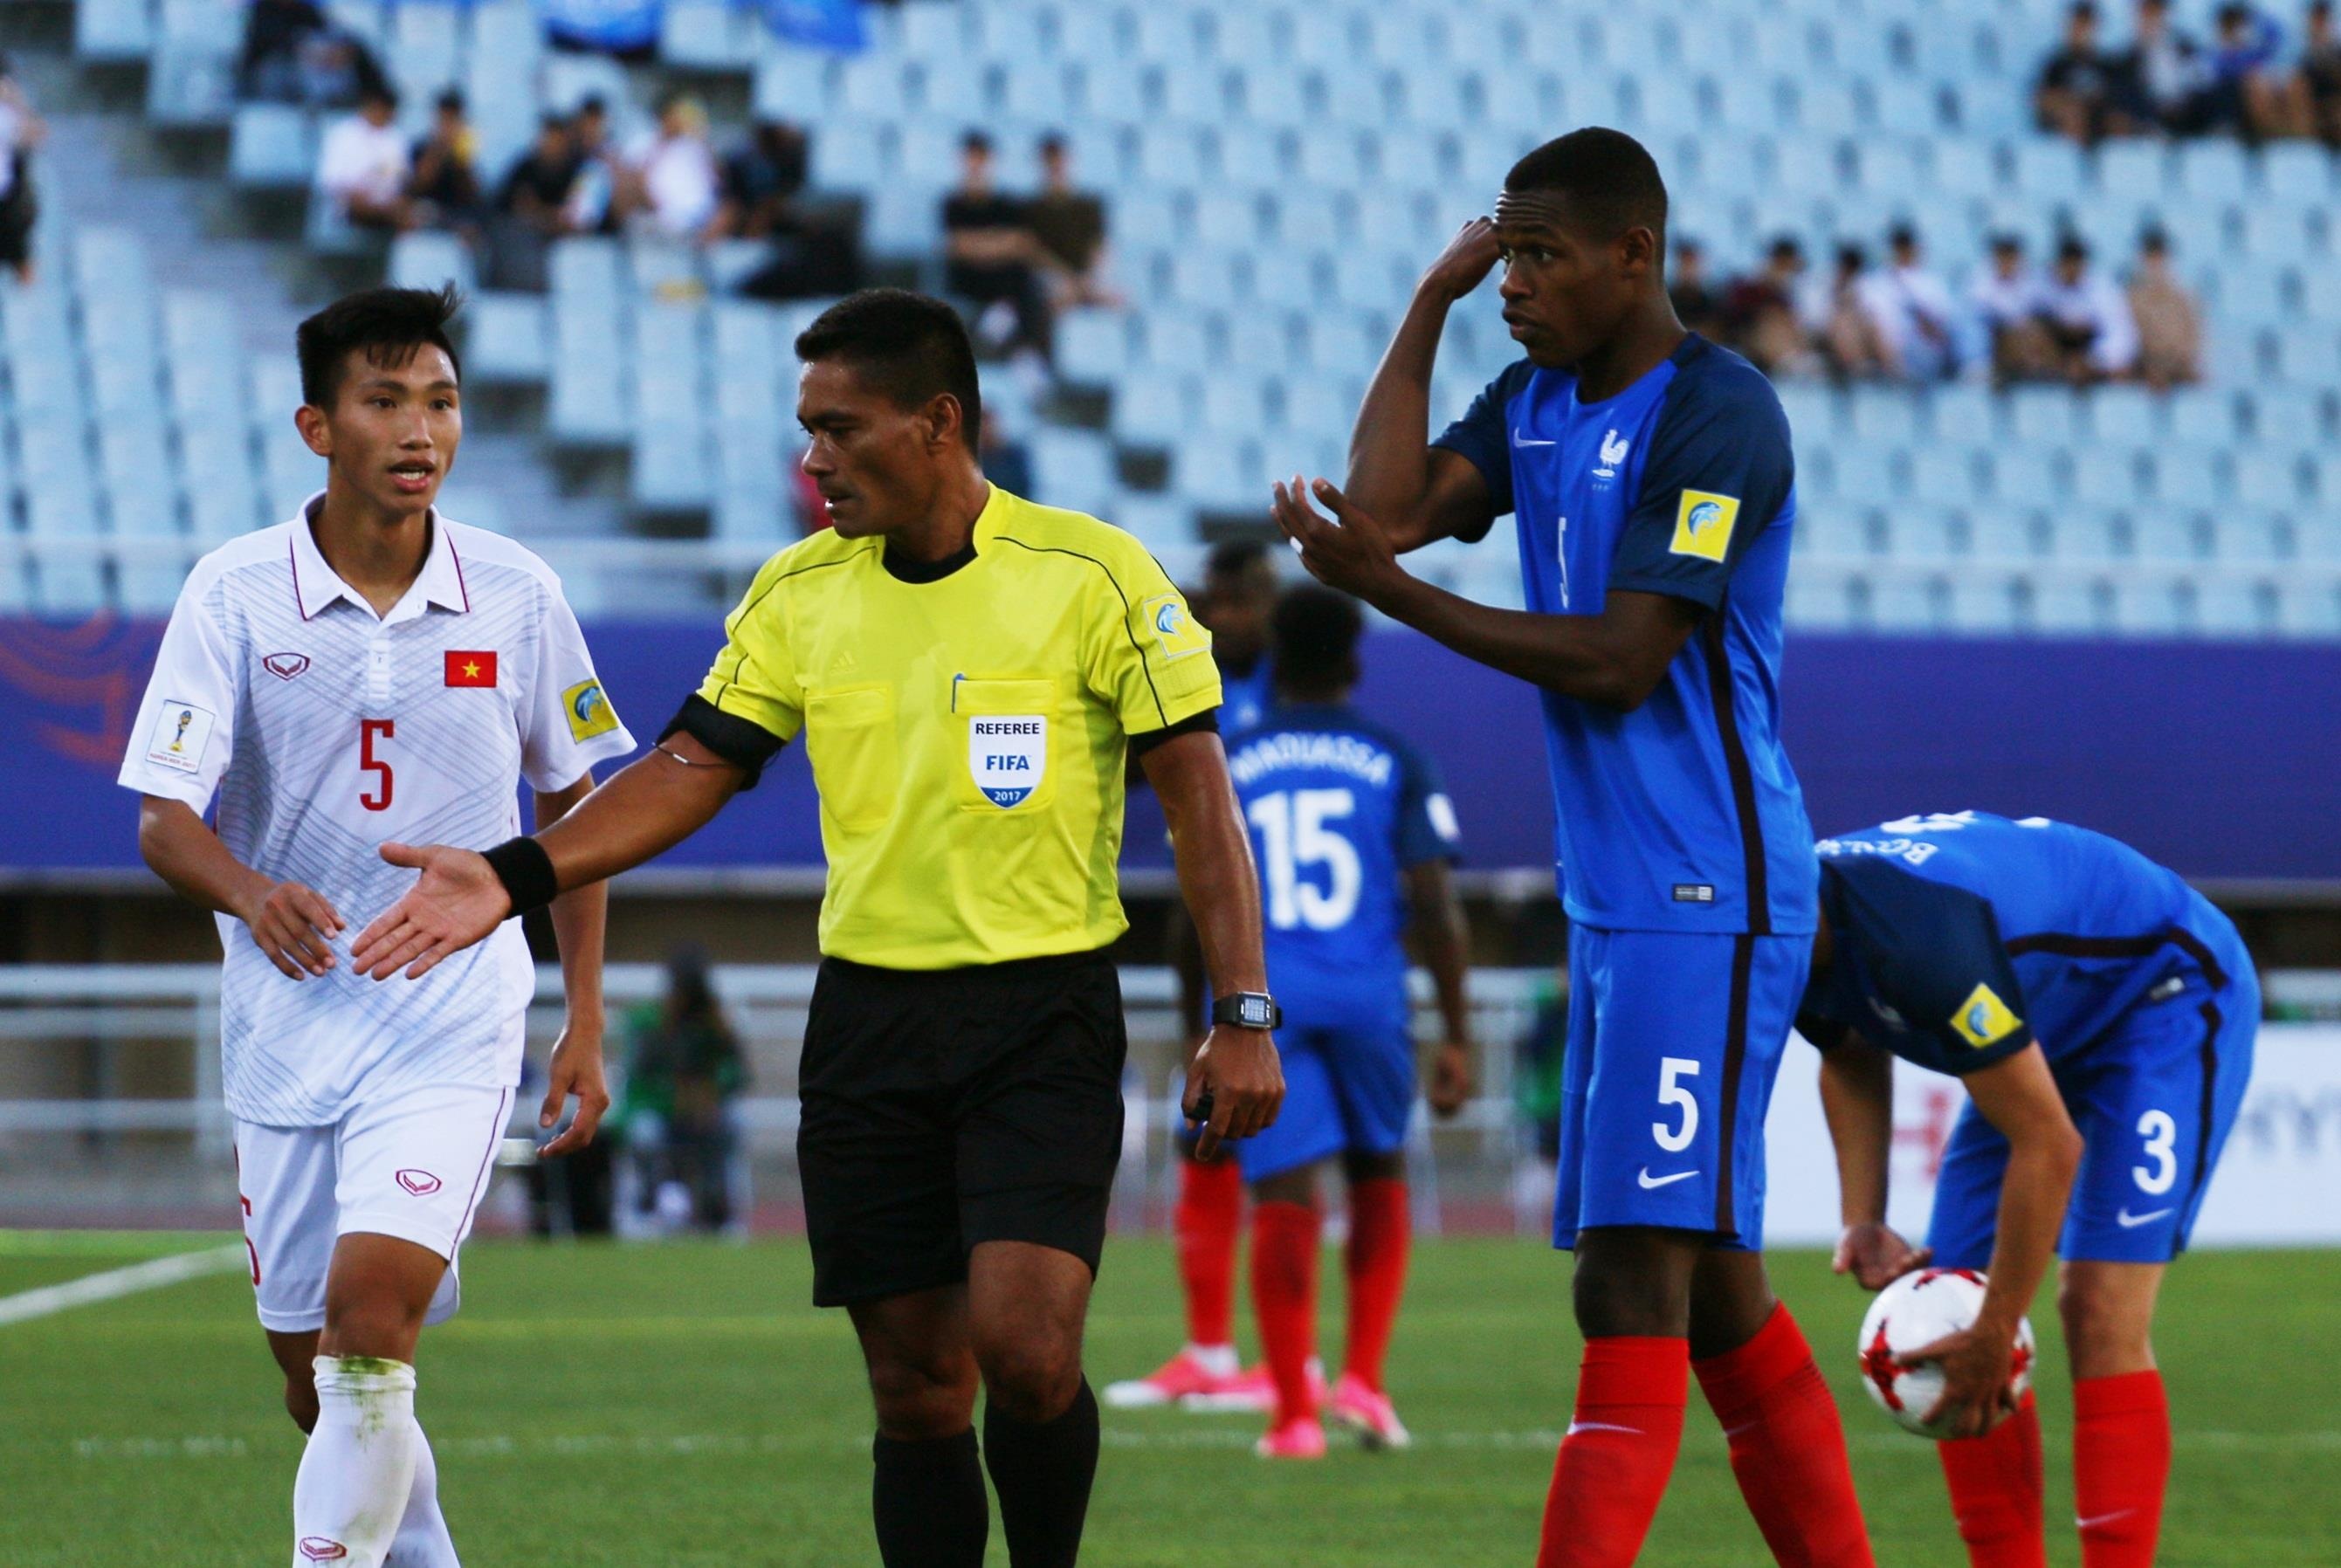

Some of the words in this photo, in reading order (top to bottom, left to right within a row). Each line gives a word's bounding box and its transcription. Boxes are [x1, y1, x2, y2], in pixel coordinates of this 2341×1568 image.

[360, 719, 395, 812] 5
[975, 722, 1041, 735] REFEREE
[985, 754, 1030, 771] FIFA
[994, 790, 1022, 801] 2017
[1248, 787, 1362, 932] 15
[1652, 1056, 1701, 1152] 5
[2131, 1108, 2178, 1196] 3
